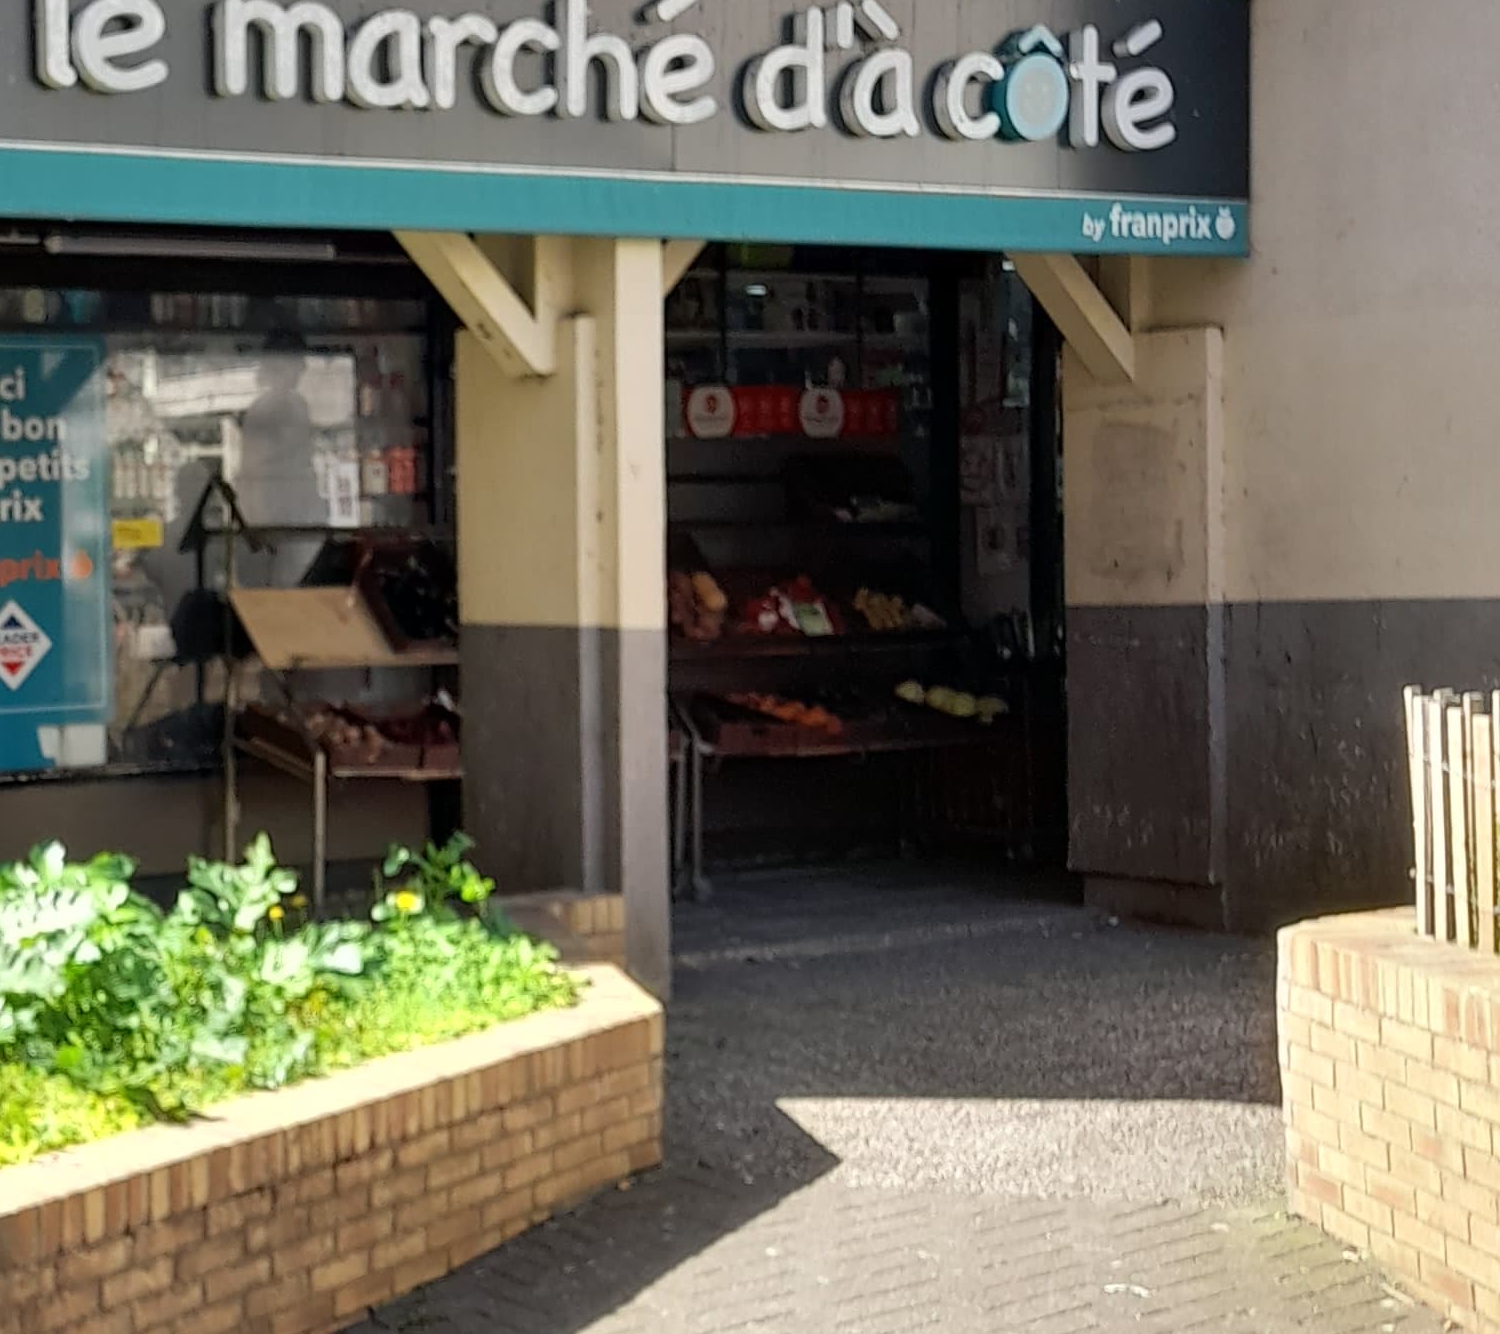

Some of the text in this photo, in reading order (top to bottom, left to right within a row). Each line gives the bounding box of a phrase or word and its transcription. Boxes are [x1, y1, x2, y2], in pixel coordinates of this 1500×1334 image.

[933, 18, 1176, 151] côté
[1082, 202, 1213, 245] by franprix
[1, 406, 69, 442] bon
